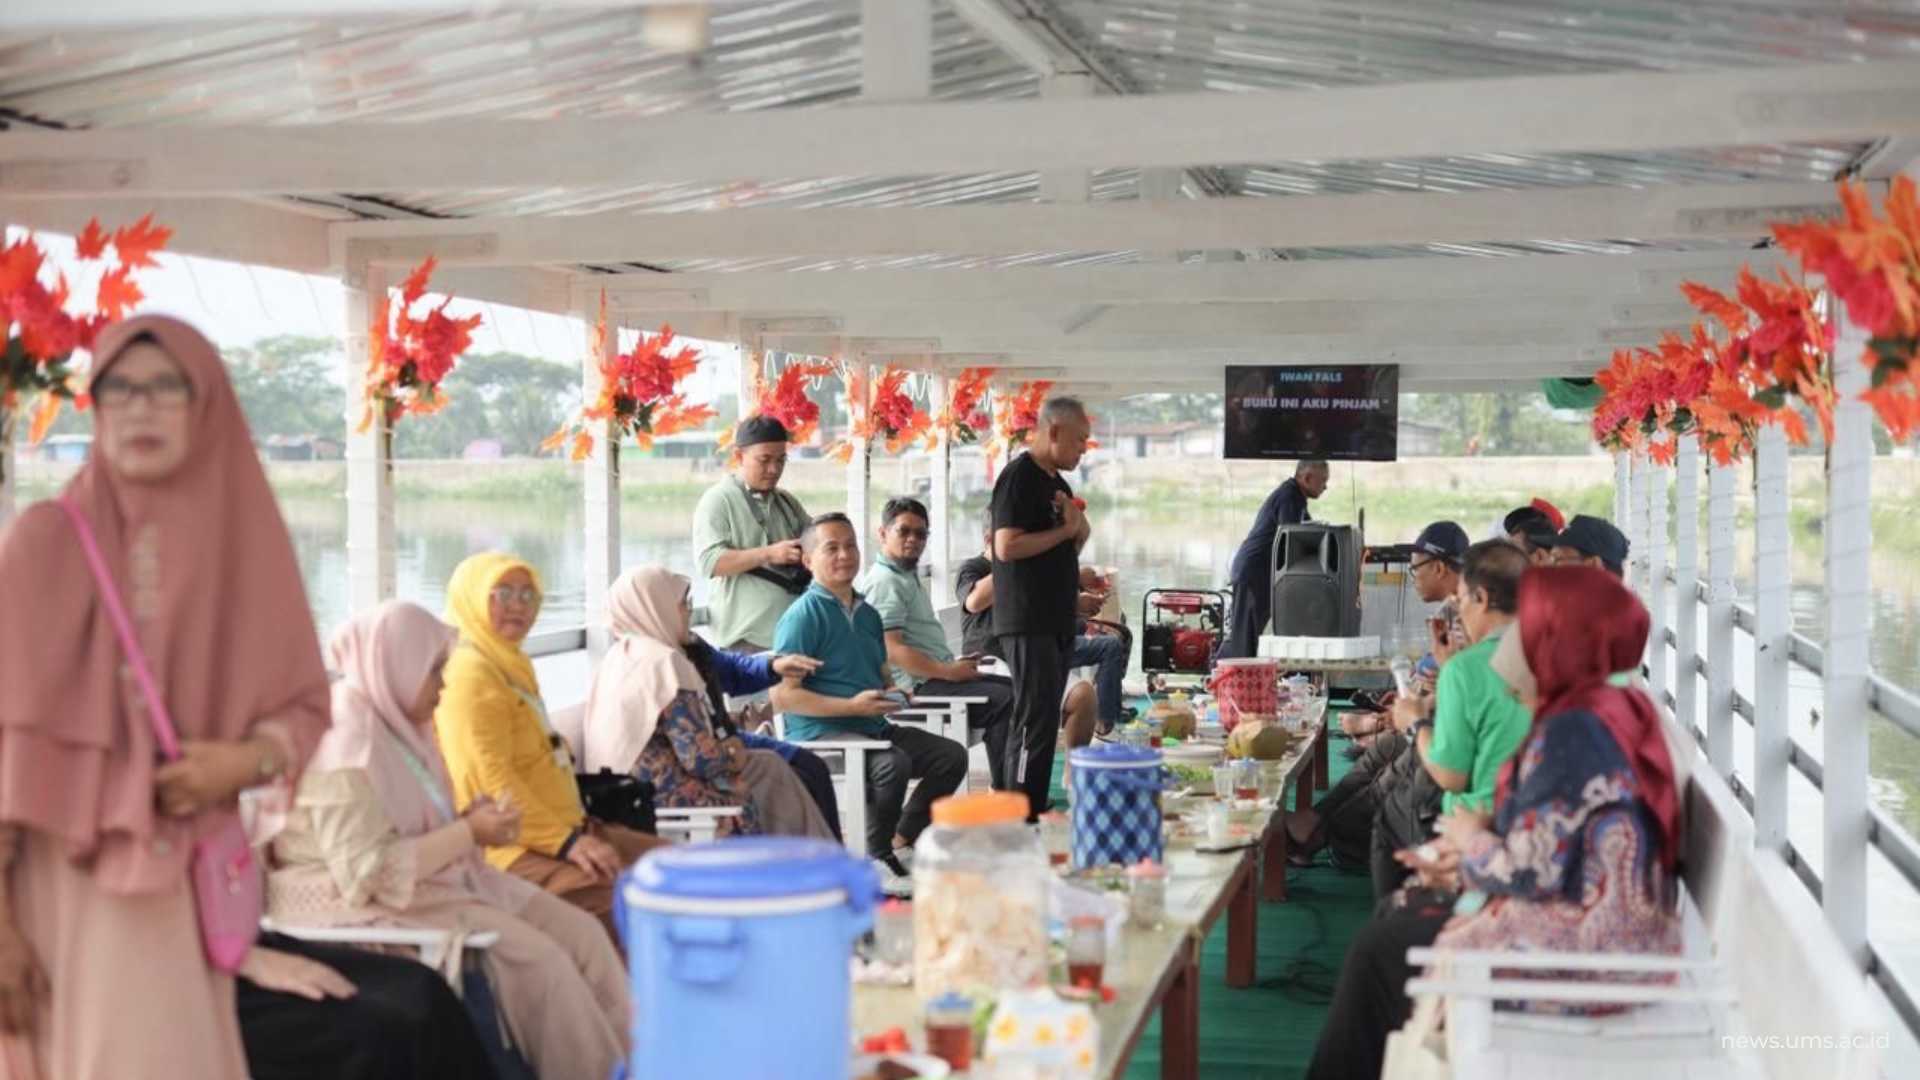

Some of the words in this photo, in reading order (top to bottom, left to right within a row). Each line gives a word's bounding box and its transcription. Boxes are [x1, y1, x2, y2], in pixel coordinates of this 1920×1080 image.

[1280, 372, 1313, 382] IWAN
[1315, 372, 1343, 382] FALS
[1280, 398, 1299, 409] INI
[1302, 398, 1329, 409] AKU
